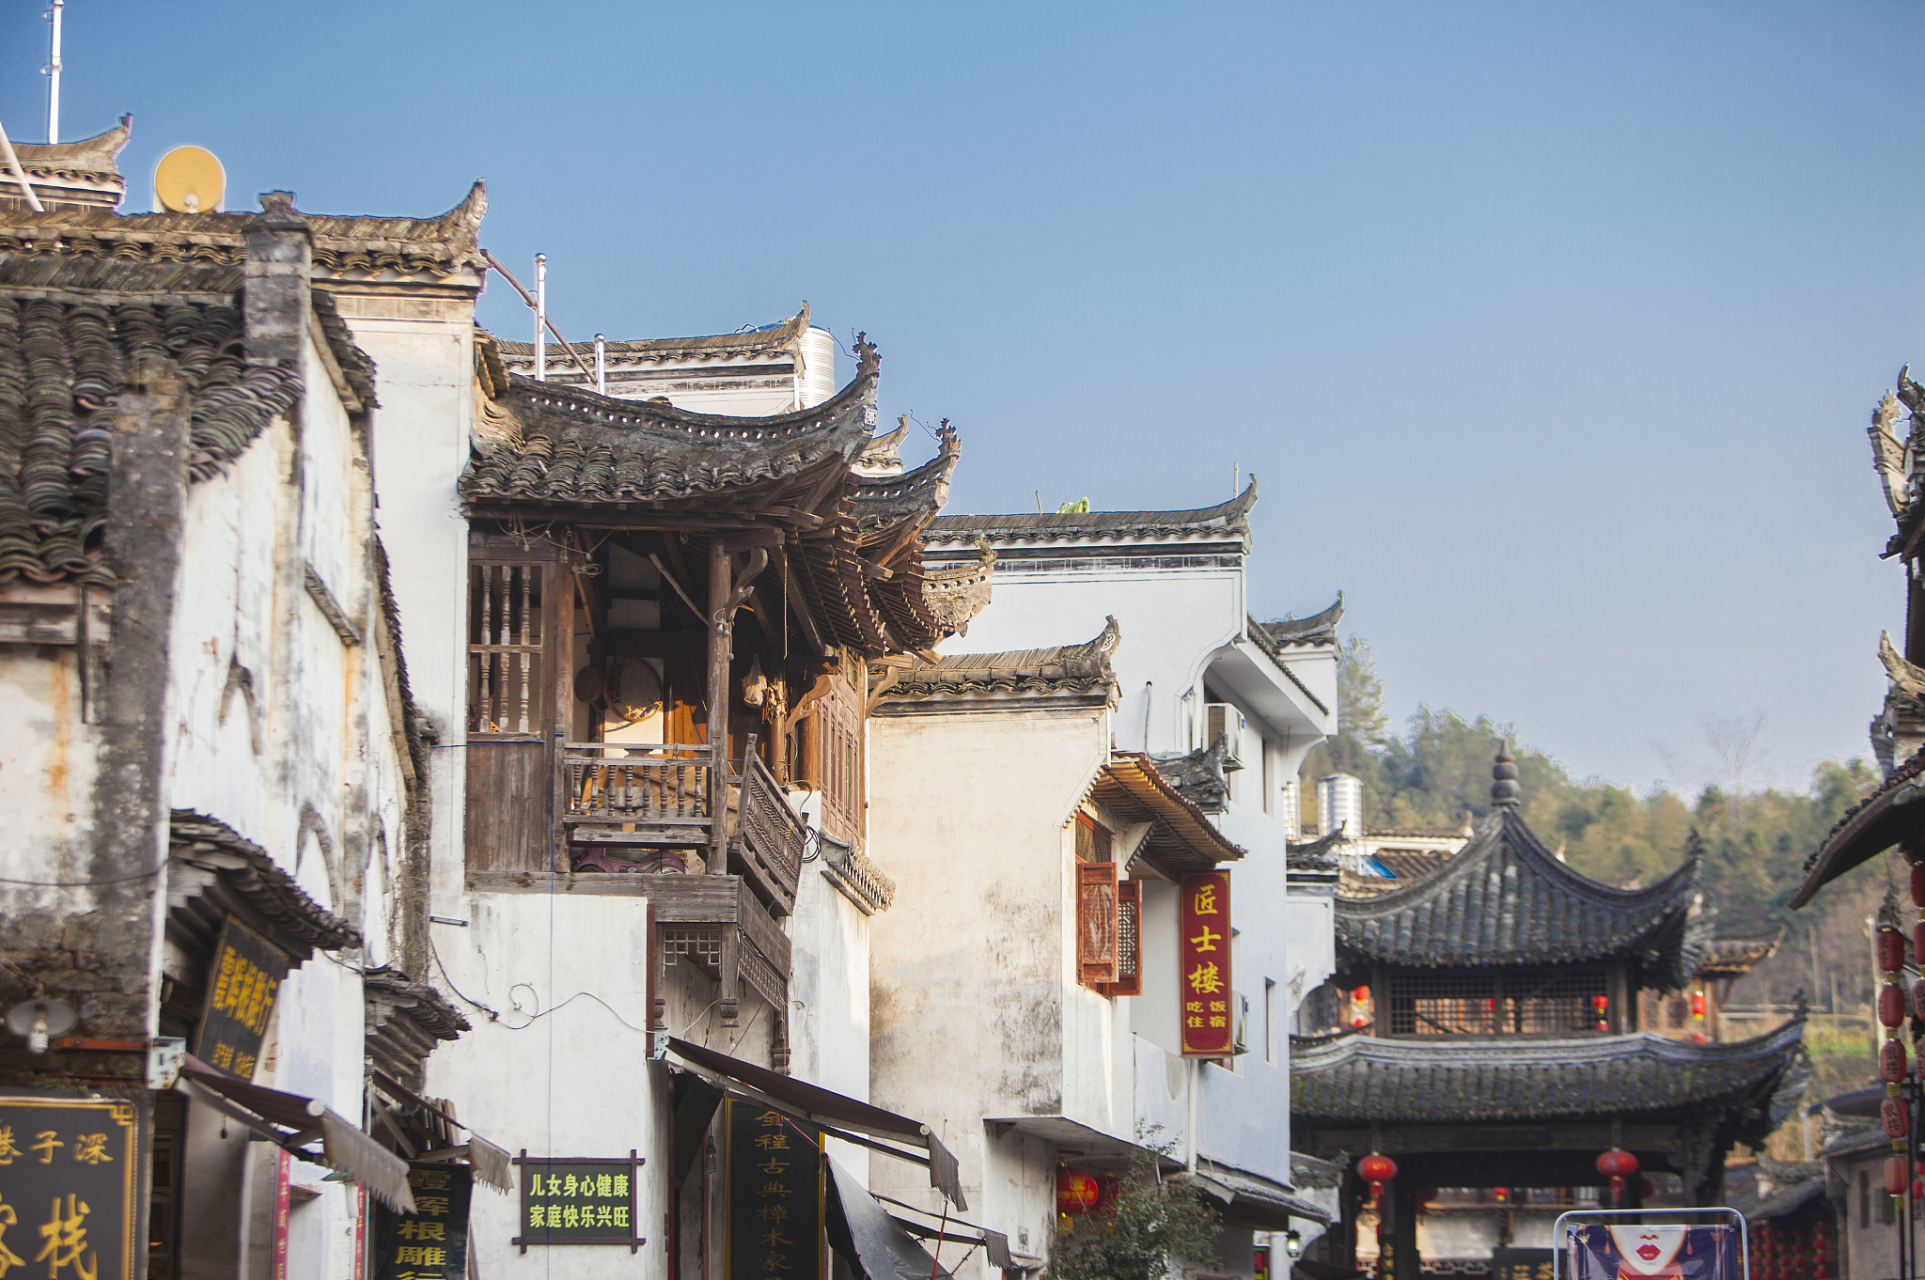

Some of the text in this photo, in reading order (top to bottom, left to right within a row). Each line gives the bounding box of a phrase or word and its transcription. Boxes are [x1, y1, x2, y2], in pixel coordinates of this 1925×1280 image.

[1188, 884, 1225, 994] 匠士楼
[1186, 1000, 1227, 1013] 吃饭
[1186, 1016, 1227, 1029] 住宿
[529, 1173, 629, 1198] 儿女身心健康
[754, 1110, 795, 1280] 全程古典樟木家
[529, 1204, 630, 1229] 家庭快乐兴旺
